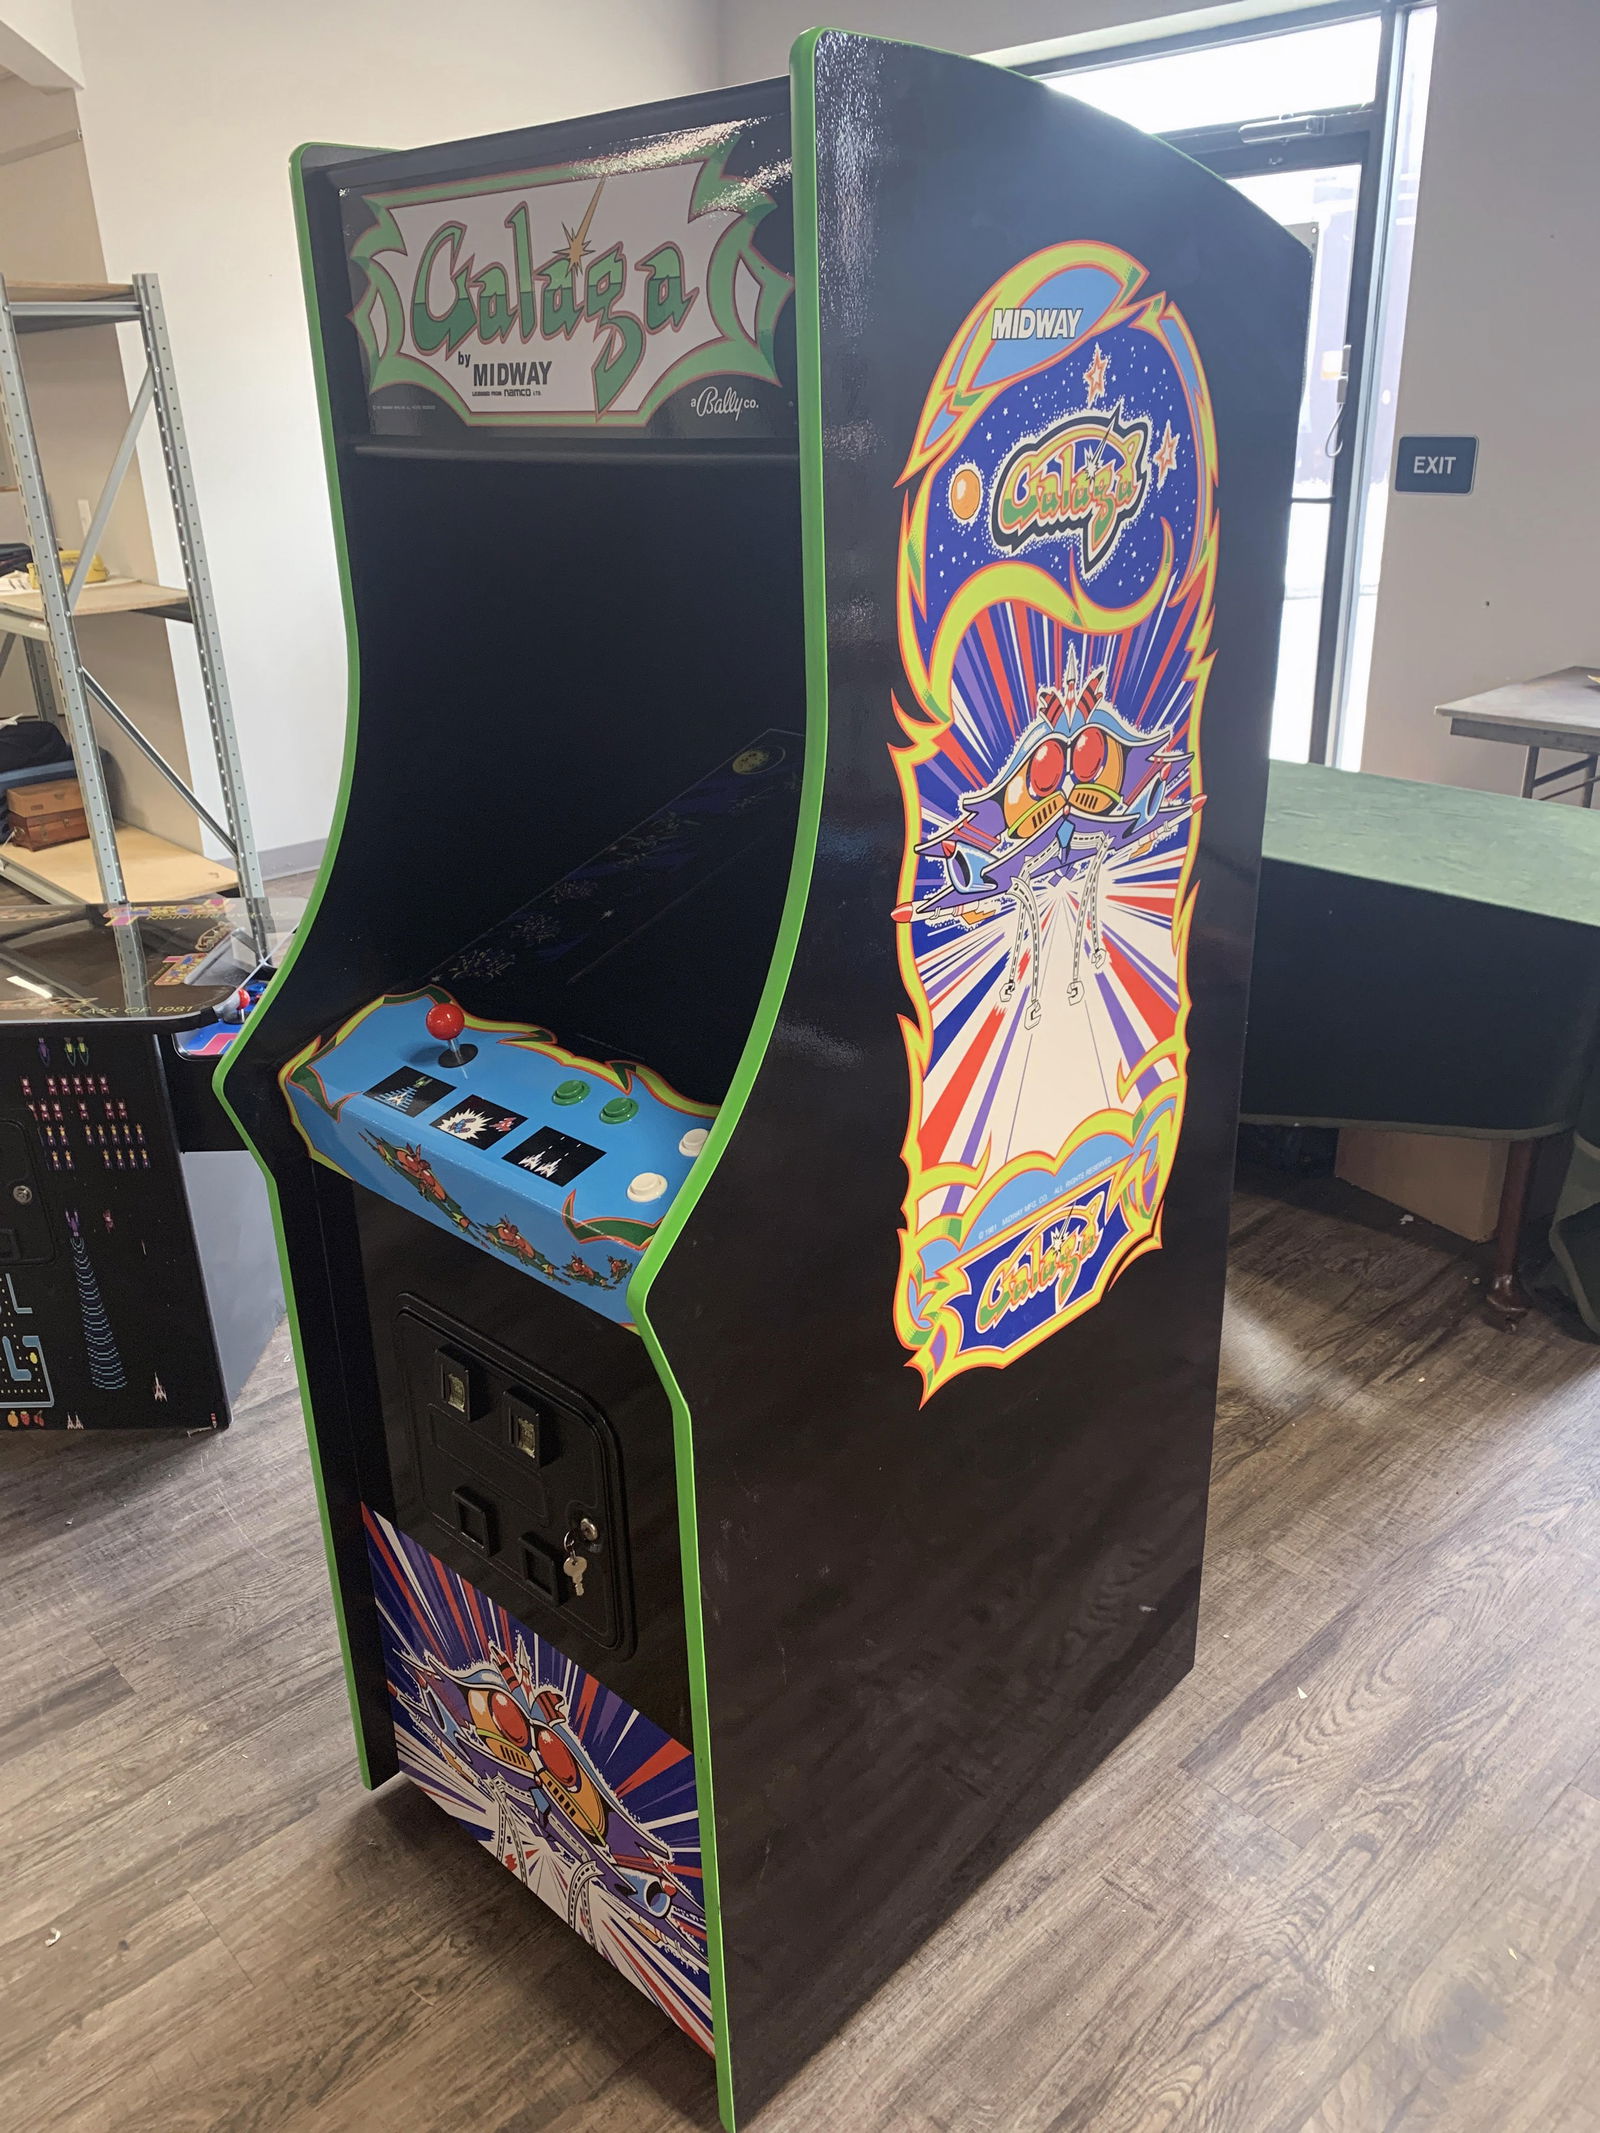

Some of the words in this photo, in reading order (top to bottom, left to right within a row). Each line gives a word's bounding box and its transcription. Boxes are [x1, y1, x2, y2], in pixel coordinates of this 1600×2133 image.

[410, 201, 699, 421] Galaga
[991, 308, 1083, 340] MIDWAY
[457, 351, 471, 368] by
[473, 361, 553, 386] MIDWAY
[503, 389, 532, 397] namco
[690, 398, 697, 408] a
[696, 386, 743, 421] Bally
[743, 399, 759, 408] co.
[1413, 456, 1457, 474] EXIT
[998, 428, 1142, 552] Galaga
[62, 1006, 119, 1015] CLASS
[124, 1006, 151, 1014] OF
[157, 1005, 193, 1013] 1981
[1001, 1209, 1023, 1226] MIDWAY
[1065, 1172, 1085, 1187] RIGHTS
[1085, 1156, 1113, 1176] RESERVED
[976, 1190, 1105, 1334] Galaga
